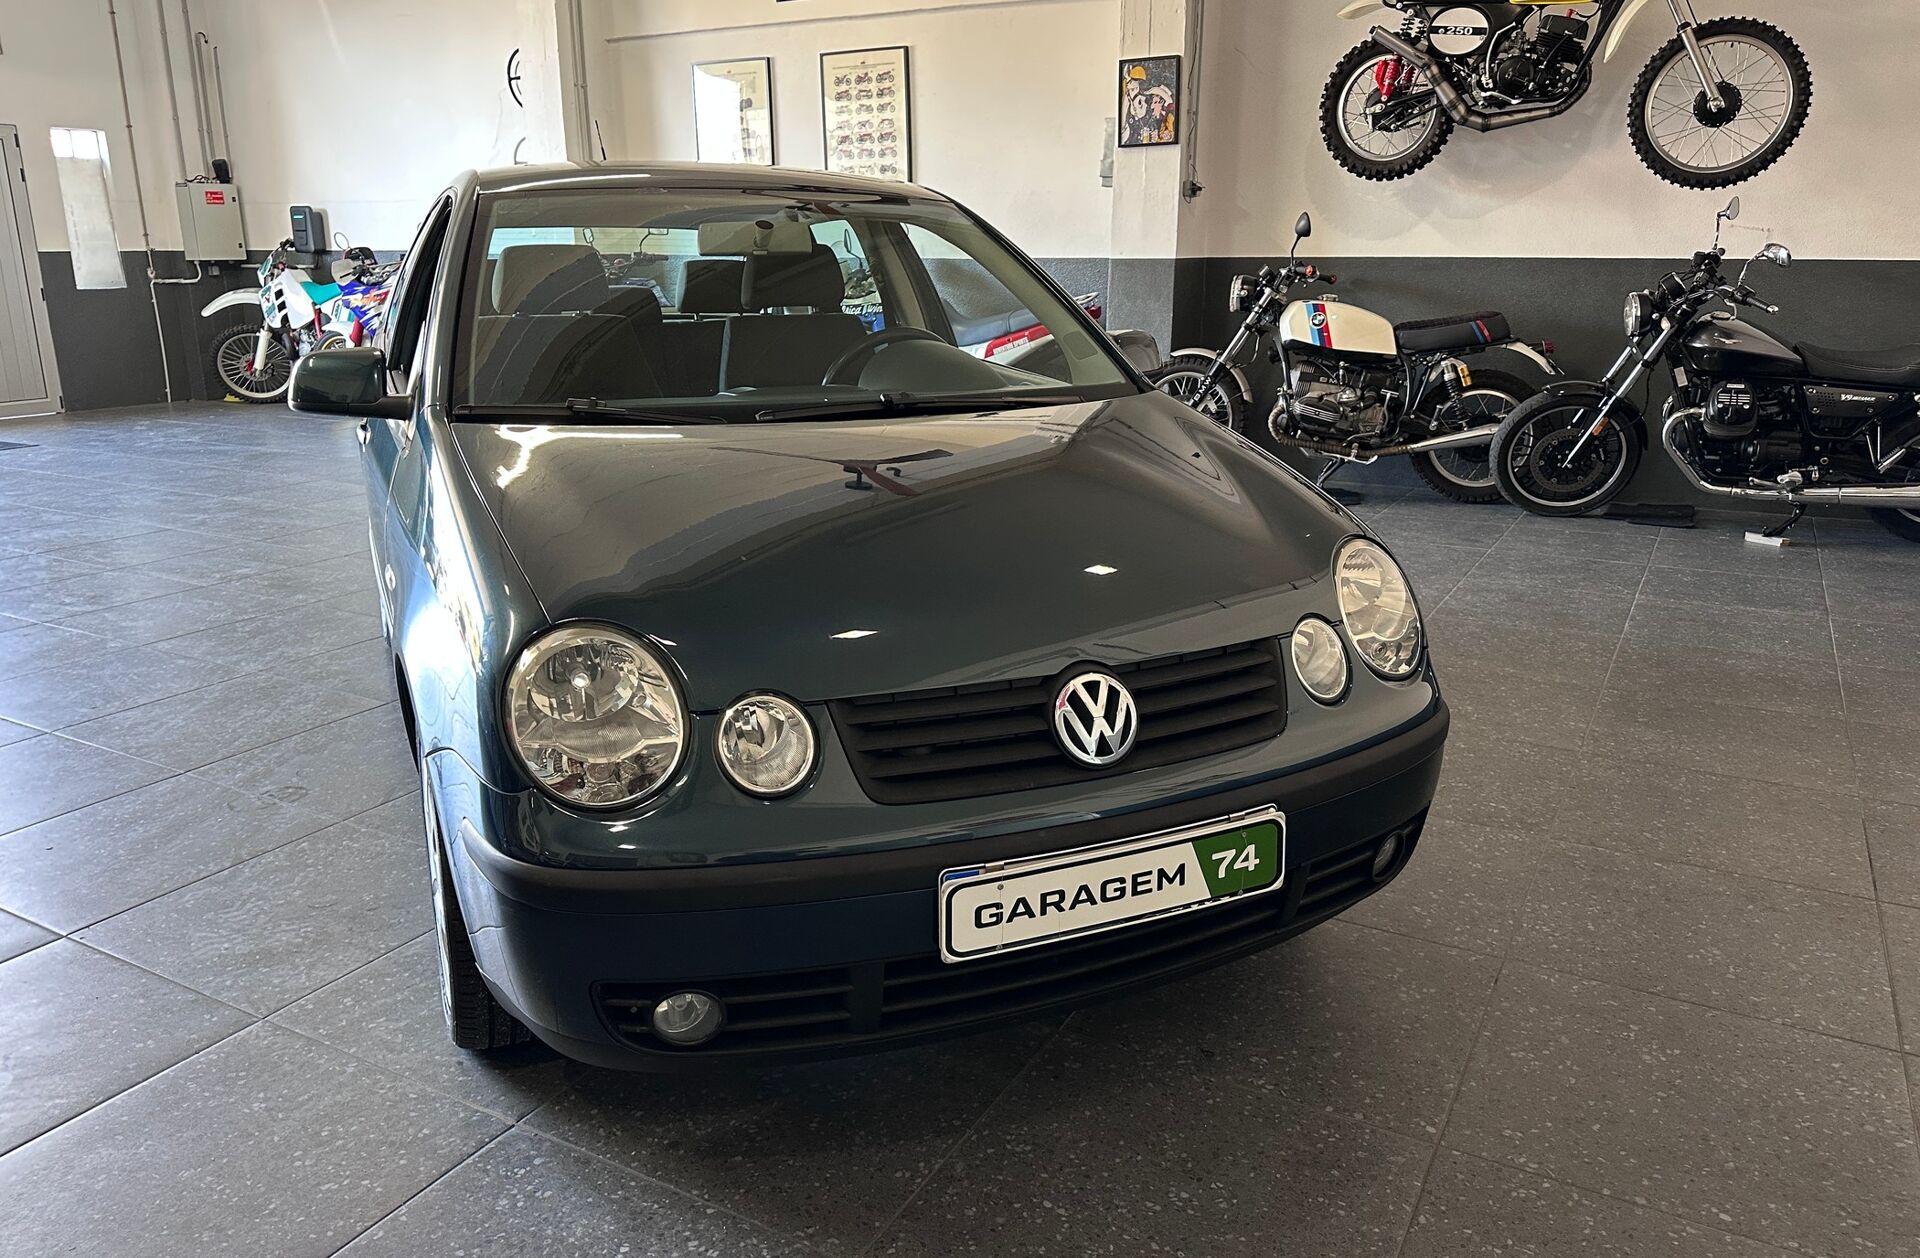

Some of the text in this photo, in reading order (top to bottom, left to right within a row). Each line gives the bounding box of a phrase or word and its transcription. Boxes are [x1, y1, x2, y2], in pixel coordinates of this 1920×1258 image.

[1446, 26, 1473, 35] 250
[861, 303, 883, 315] Twin
[1193, 376, 1211, 401] BMW
[974, 844, 1260, 930] GARAGEM 74
